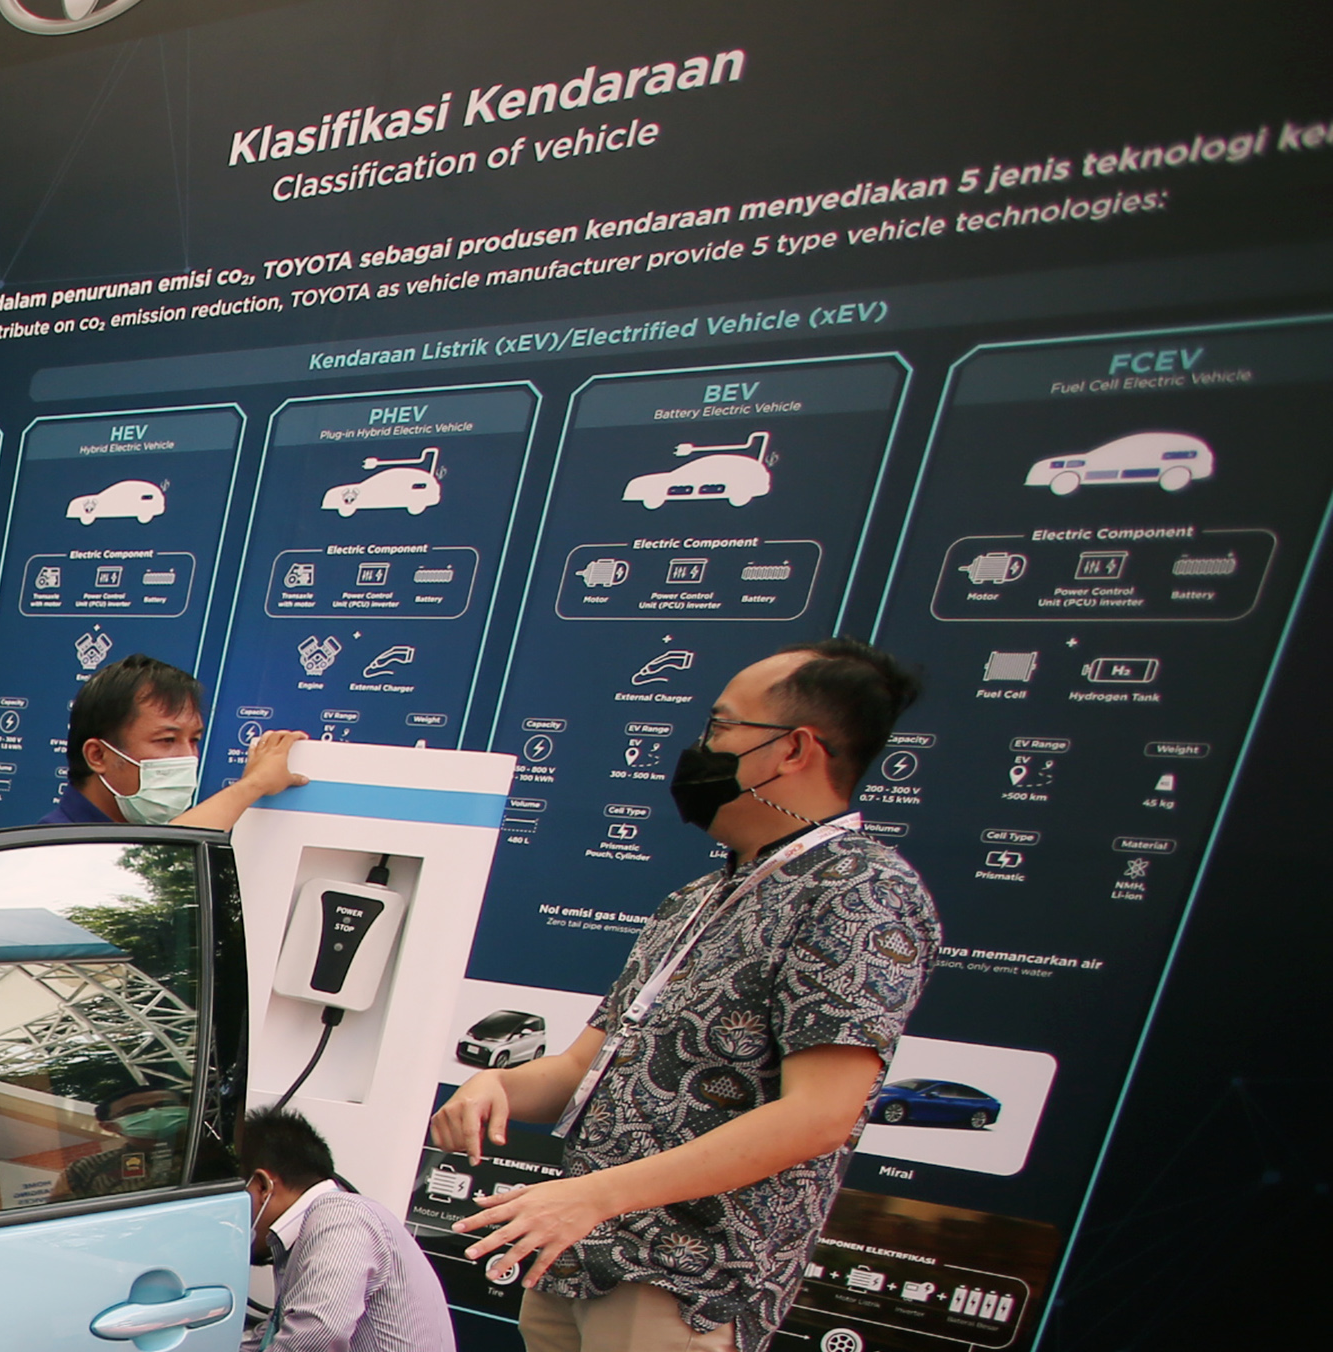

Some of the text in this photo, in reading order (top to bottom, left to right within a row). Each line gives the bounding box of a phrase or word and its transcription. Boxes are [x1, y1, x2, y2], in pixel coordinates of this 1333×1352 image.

[229, 50, 744, 166] Klasifikasi Kendaraan
[273, 119, 659, 201] Classification of vehicle
[51, 280, 152, 308] penurunan
[158, 268, 212, 292] emisi
[264, 251, 352, 279] TOYOTA
[359, 238, 453, 268] sebagai
[457, 226, 578, 259] produsen
[585, 206, 730, 240] kendaraan
[739, 178, 948, 220] menyediakan
[957, 168, 980, 193] 5
[984, 158, 1070, 194] jenis
[1082, 127, 1267, 177] teknologi
[54, 320, 75, 333] on
[111, 306, 186, 327] emission
[191, 296, 283, 319] reduction,
[291, 283, 370, 307] TOYOTA
[377, 283, 400, 298] as
[407, 271, 480, 295] vehicle
[486, 255, 642, 286] manufacturer
[646, 240, 744, 271] provide
[752, 236, 769, 256] 5
[777, 232, 837, 256] type
[848, 216, 946, 245] vehicle
[956, 191, 1167, 232] technologies:
[309, 348, 416, 370] Kendaraan
[422, 338, 489, 360] Listrik
[707, 310, 800, 335] Vehicle
[809, 301, 888, 328] (xEV)
[1107, 347, 1204, 376] FCEV
[703, 382, 760, 403] BEV
[1050, 370, 1252, 394] Fuel Cell Electric Vehicle
[368, 404, 429, 426] PHEV
[654, 401, 802, 419] Battery Electric Vehicle
[109, 422, 148, 444] HEV
[320, 422, 473, 441] Plug-in Hybrid Electric Vehicle
[79, 441, 175, 455] Hybrid Electric Vehicle
[633, 537, 759, 549] Electric Component
[1032, 526, 1194, 541] Electric Component
[976, 689, 1027, 699] Fuel Cell
[1069, 692, 1160, 702] Hydrogen Tank
[336, 906, 363, 919] POWER
[538, 903, 648, 926] Nol emisi gas buan
[334, 922, 355, 932] STOP
[493, 1157, 564, 1179] ELEMENT BEV
[879, 1166, 914, 1180] Mirai
